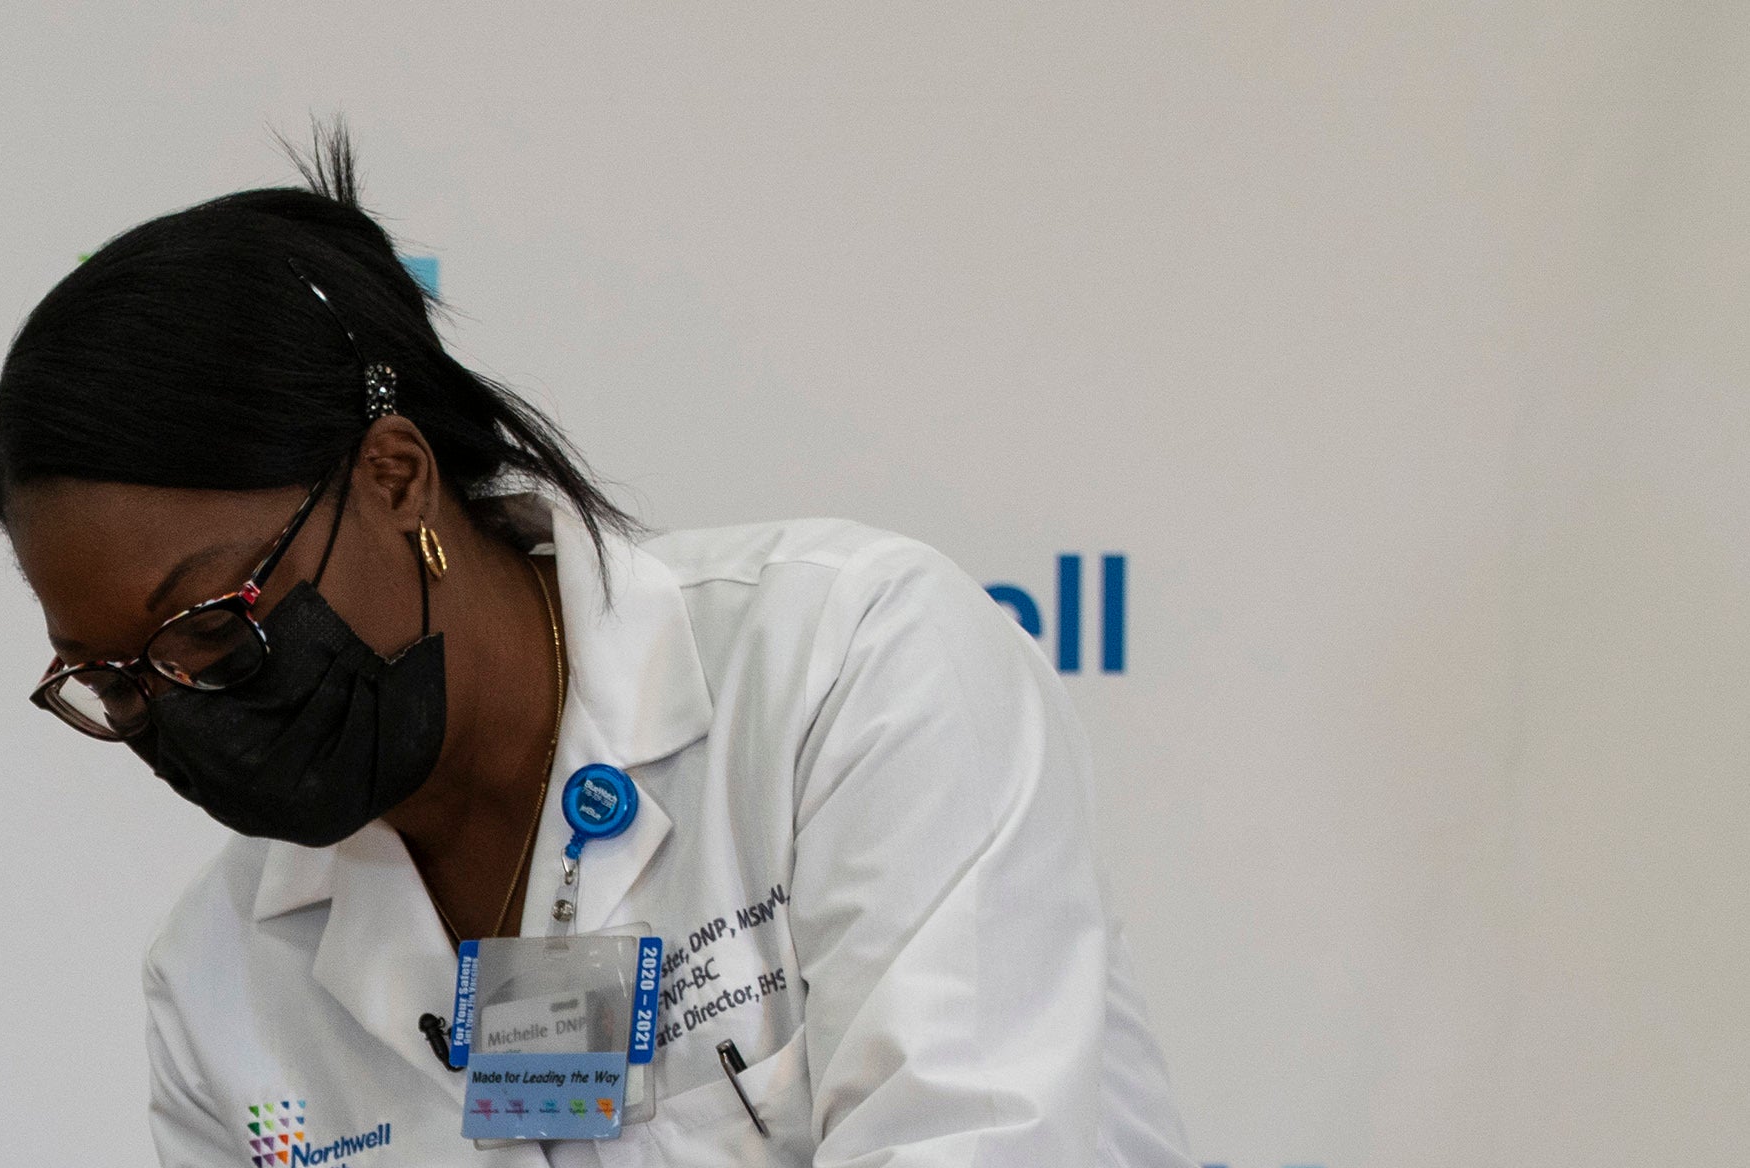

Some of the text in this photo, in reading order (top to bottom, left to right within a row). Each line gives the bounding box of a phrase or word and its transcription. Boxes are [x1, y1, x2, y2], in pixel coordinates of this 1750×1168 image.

[689, 917, 736, 953] DNP,
[640, 947, 658, 990] 2020
[453, 956, 472, 1046] For Your Safety
[683, 985, 760, 1031] Director,
[757, 967, 787, 996] EHS
[488, 1023, 548, 1047] Michelle
[634, 1009, 653, 1050] 2021
[472, 1070, 620, 1087] Made for Leading the Way
